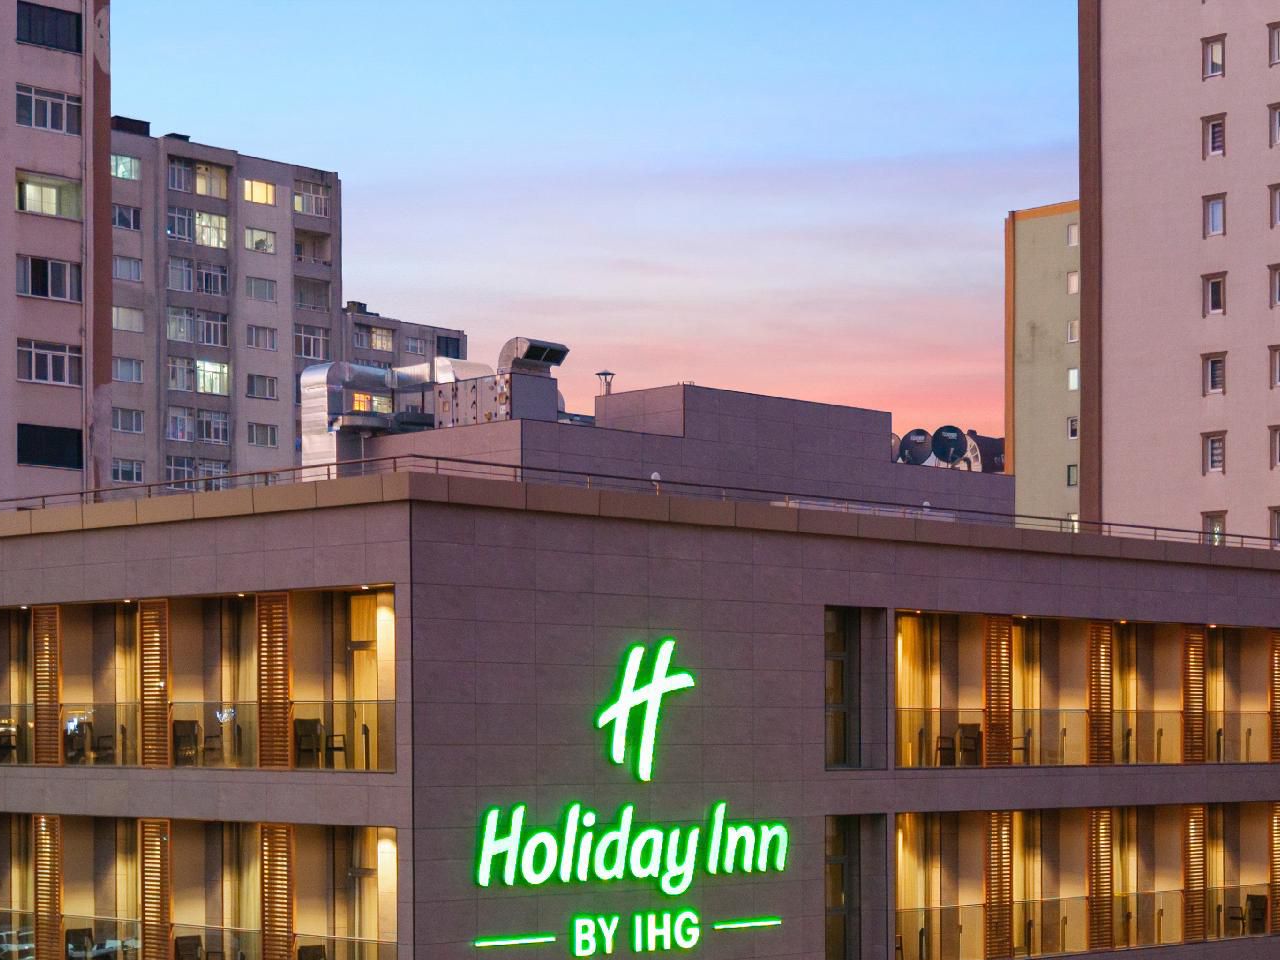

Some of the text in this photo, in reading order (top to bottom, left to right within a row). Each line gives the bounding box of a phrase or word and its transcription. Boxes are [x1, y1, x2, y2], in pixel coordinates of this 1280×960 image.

[596, 639, 695, 783] H
[476, 801, 788, 895] Holiday Inn
[573, 910, 700, 957] BY IHG
